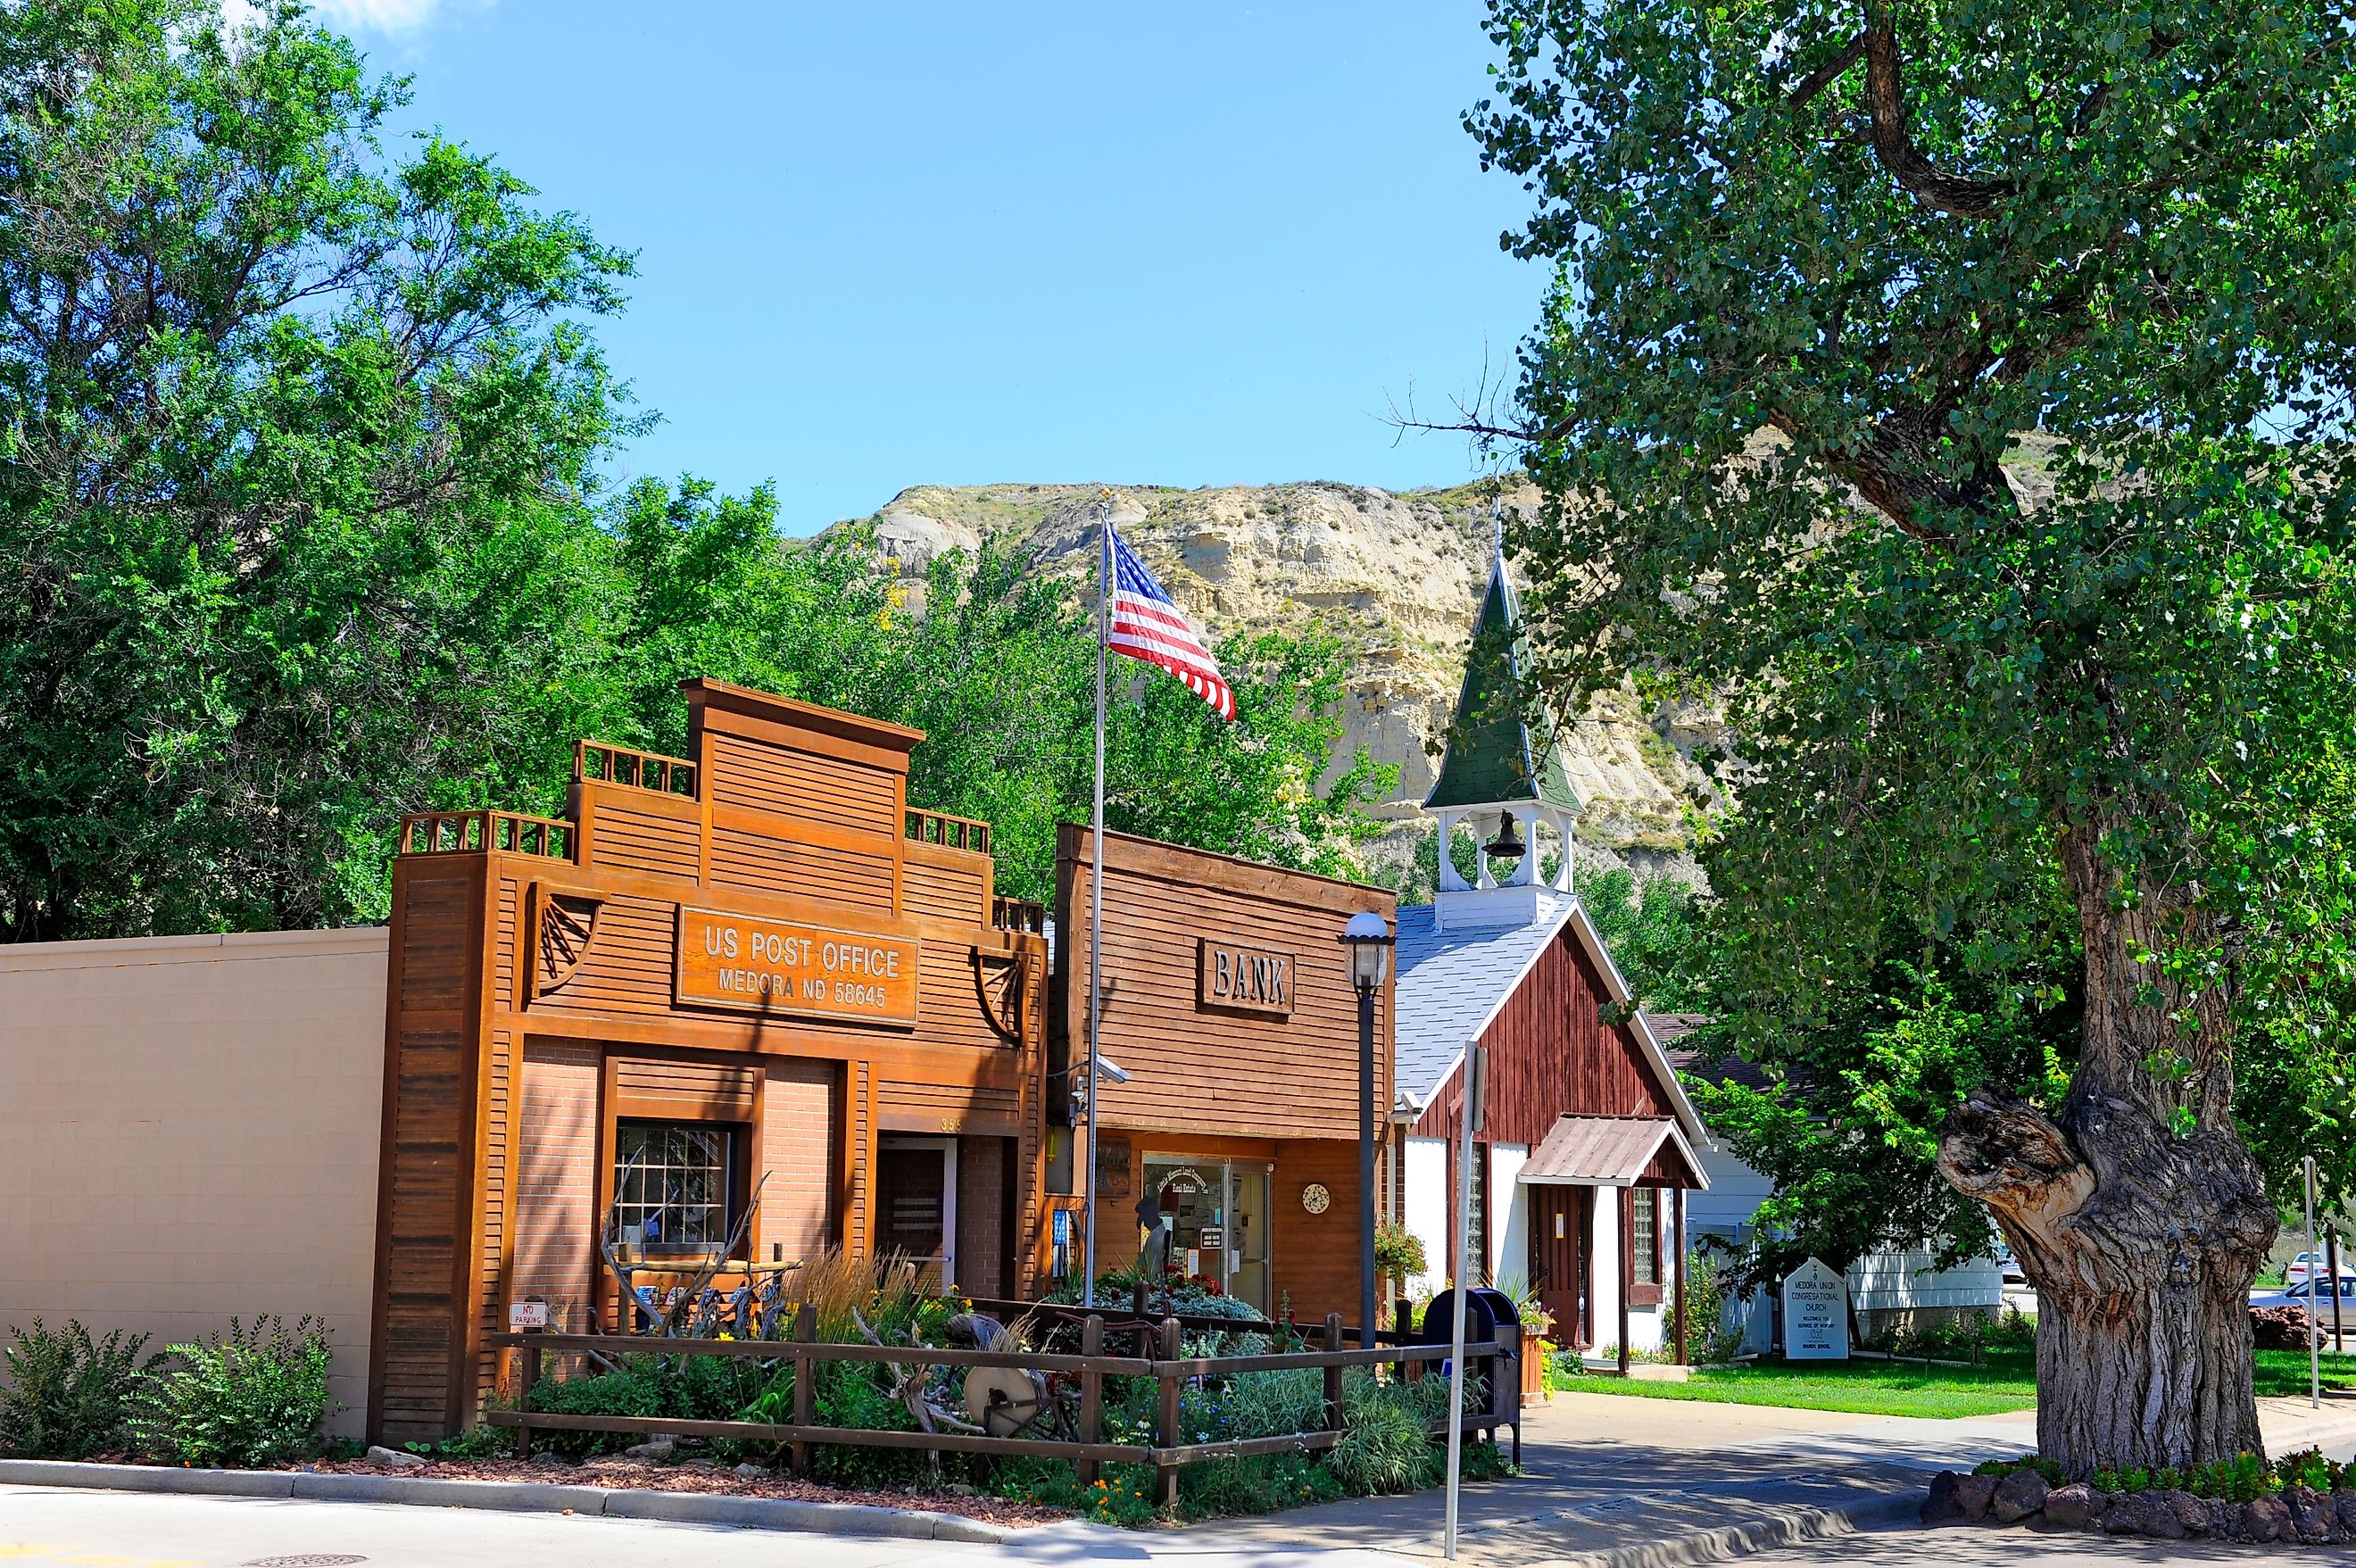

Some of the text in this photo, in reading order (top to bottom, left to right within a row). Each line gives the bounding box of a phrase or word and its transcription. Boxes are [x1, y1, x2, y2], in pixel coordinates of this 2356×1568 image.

[706, 925, 900, 978] US POST OFFICE
[1215, 950, 1285, 1002] BANK
[718, 967, 885, 1008] MEDORA ND 58645
[942, 1117, 962, 1132] 355
[1795, 1281, 1836, 1290] MEDORA UNION
[1792, 1291, 1839, 1300] CONGREGATIONAL
[522, 1306, 534, 1315] NO
[1805, 1303, 1827, 1311] CHURCH
[515, 1316, 542, 1324] PARKING
